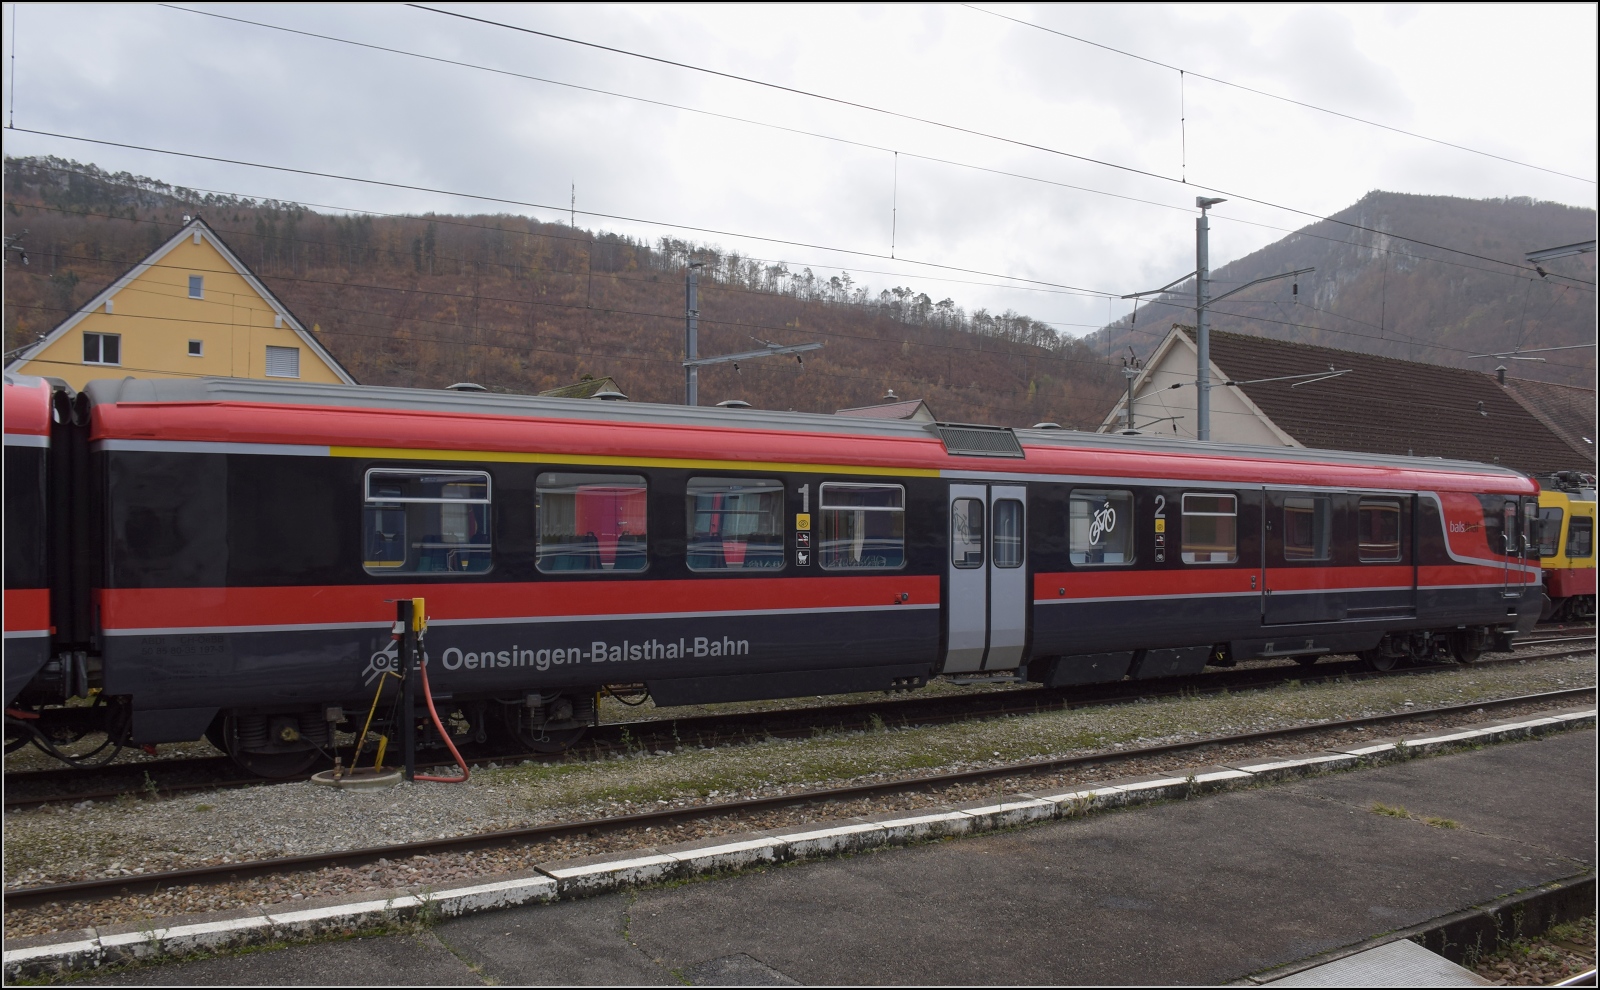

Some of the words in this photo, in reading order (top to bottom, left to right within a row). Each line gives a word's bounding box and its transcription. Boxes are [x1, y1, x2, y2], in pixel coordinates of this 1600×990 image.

[797, 483, 810, 513] 1
[1154, 494, 1166, 519] 2
[441, 636, 750, 671] Oensingen-Balsthal-Bahn
